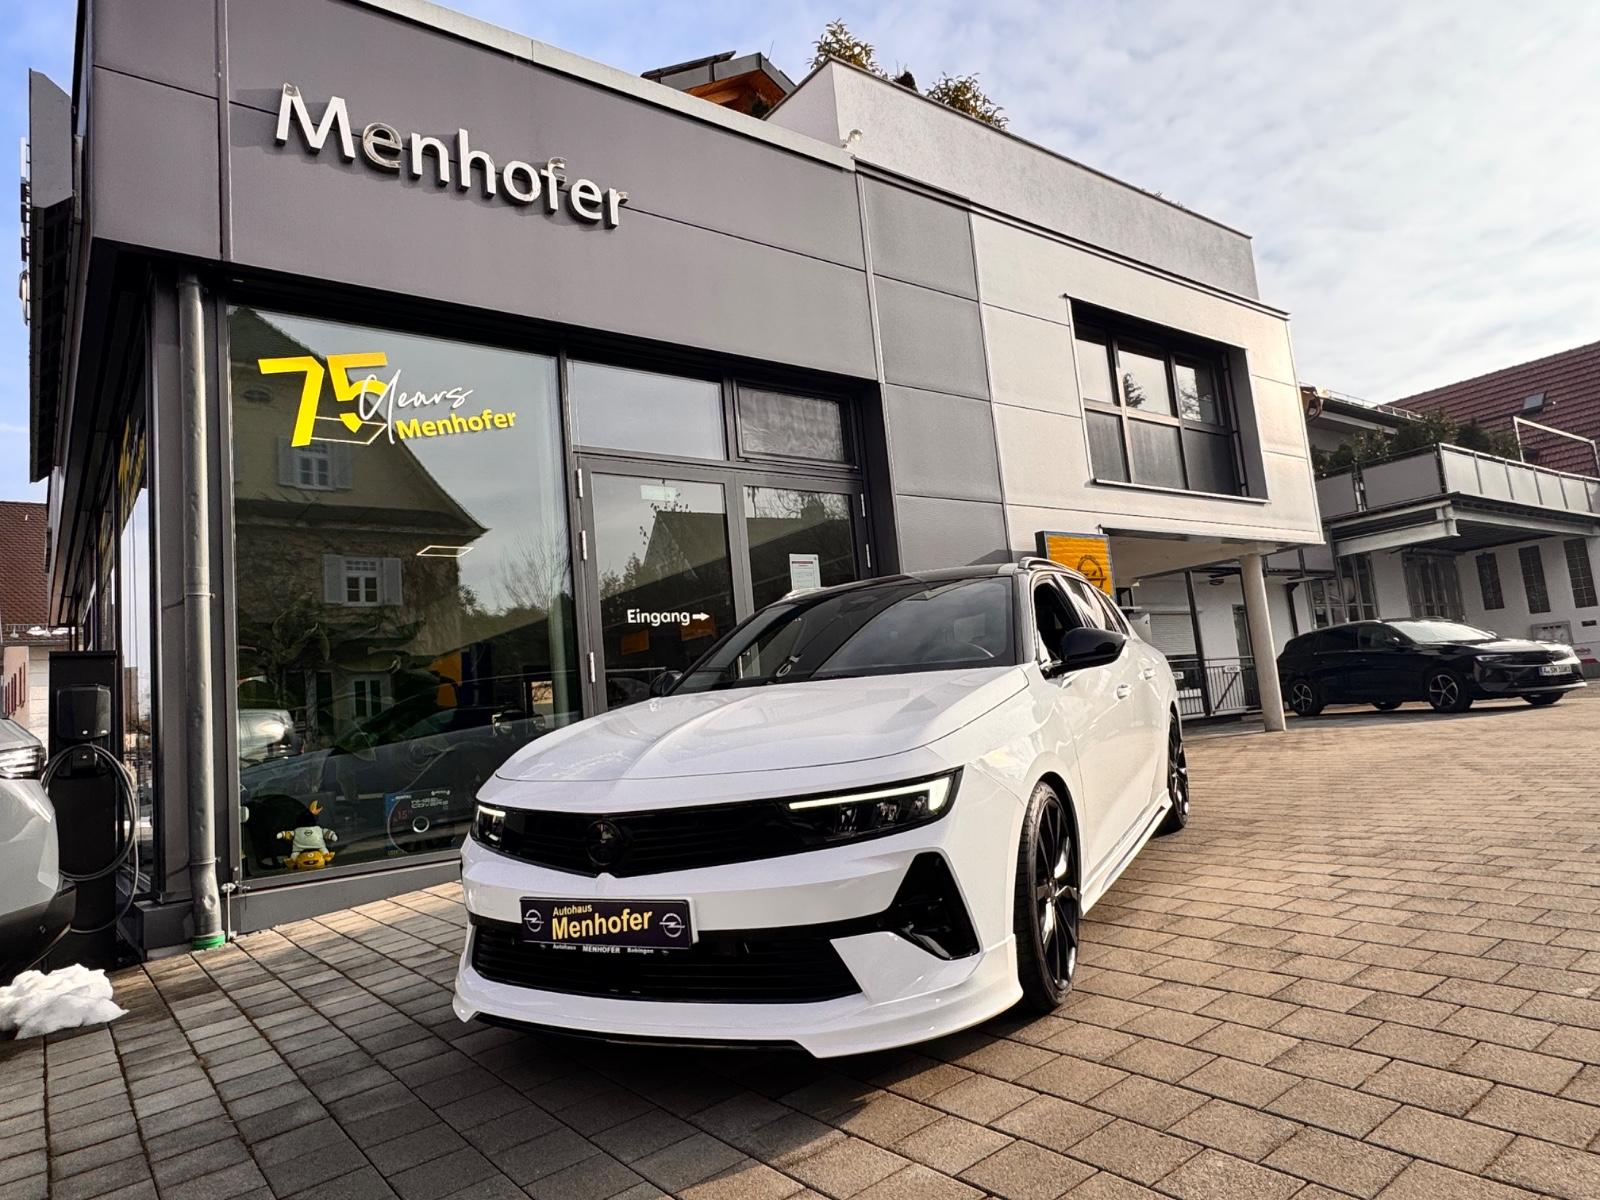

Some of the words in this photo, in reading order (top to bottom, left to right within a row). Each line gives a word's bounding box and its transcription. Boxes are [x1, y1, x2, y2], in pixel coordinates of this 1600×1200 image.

[275, 82, 629, 230] Menhofer
[257, 351, 389, 447] 75
[358, 368, 473, 445] Years
[395, 408, 517, 440] Menhofer
[627, 608, 691, 627] Eingang
[552, 909, 653, 940] Menhofer
[553, 904, 593, 917] Autohaus
[552, 943, 577, 951] Autohaus
[582, 945, 621, 954] MENHOFER
